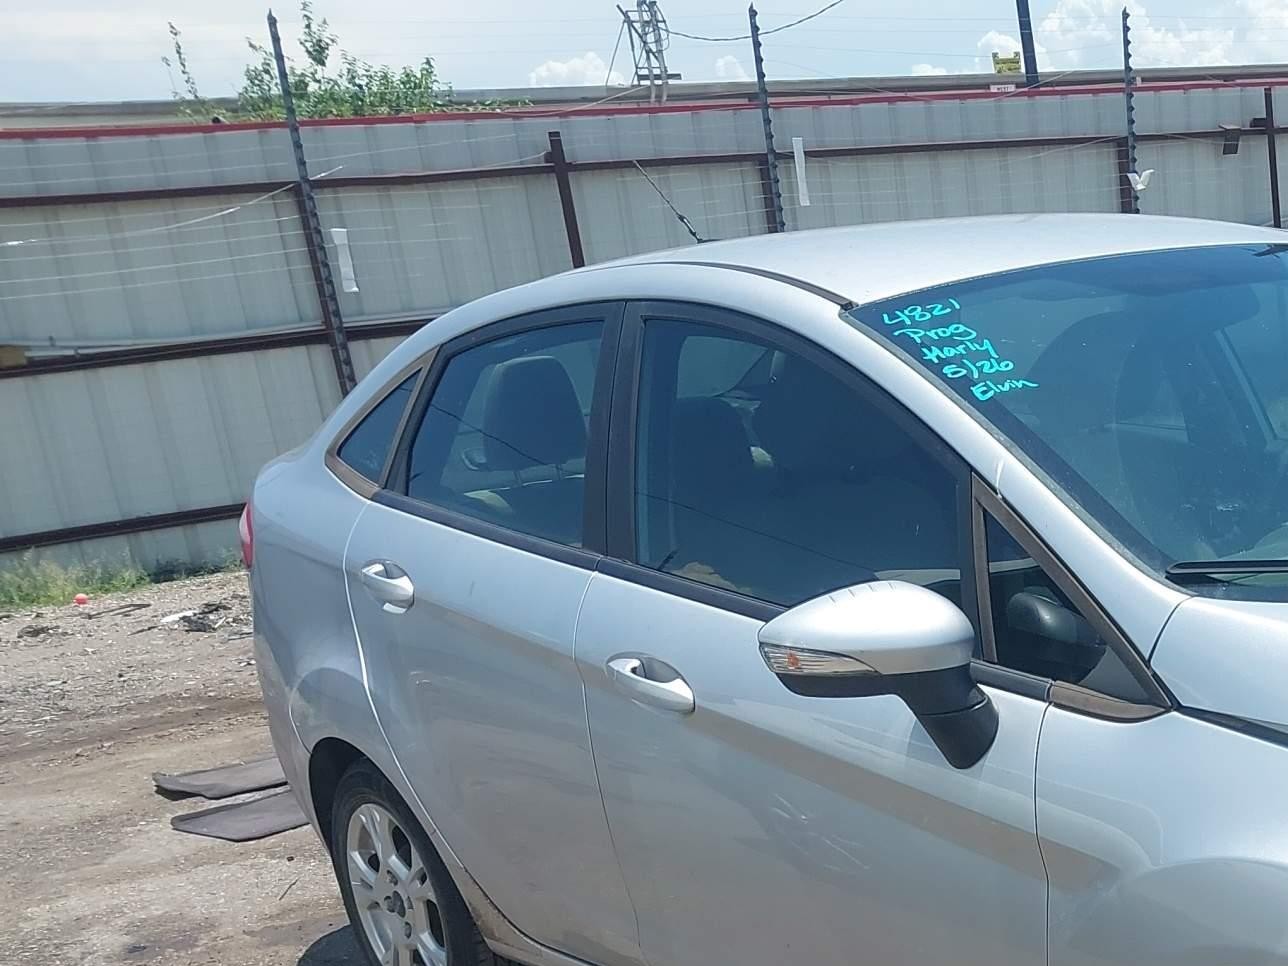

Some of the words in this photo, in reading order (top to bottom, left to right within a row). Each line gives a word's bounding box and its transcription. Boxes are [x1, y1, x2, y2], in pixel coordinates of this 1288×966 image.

[883, 299, 960, 324] 4821
[893, 324, 977, 343] Prog
[970, 379, 1040, 401] Elvin
